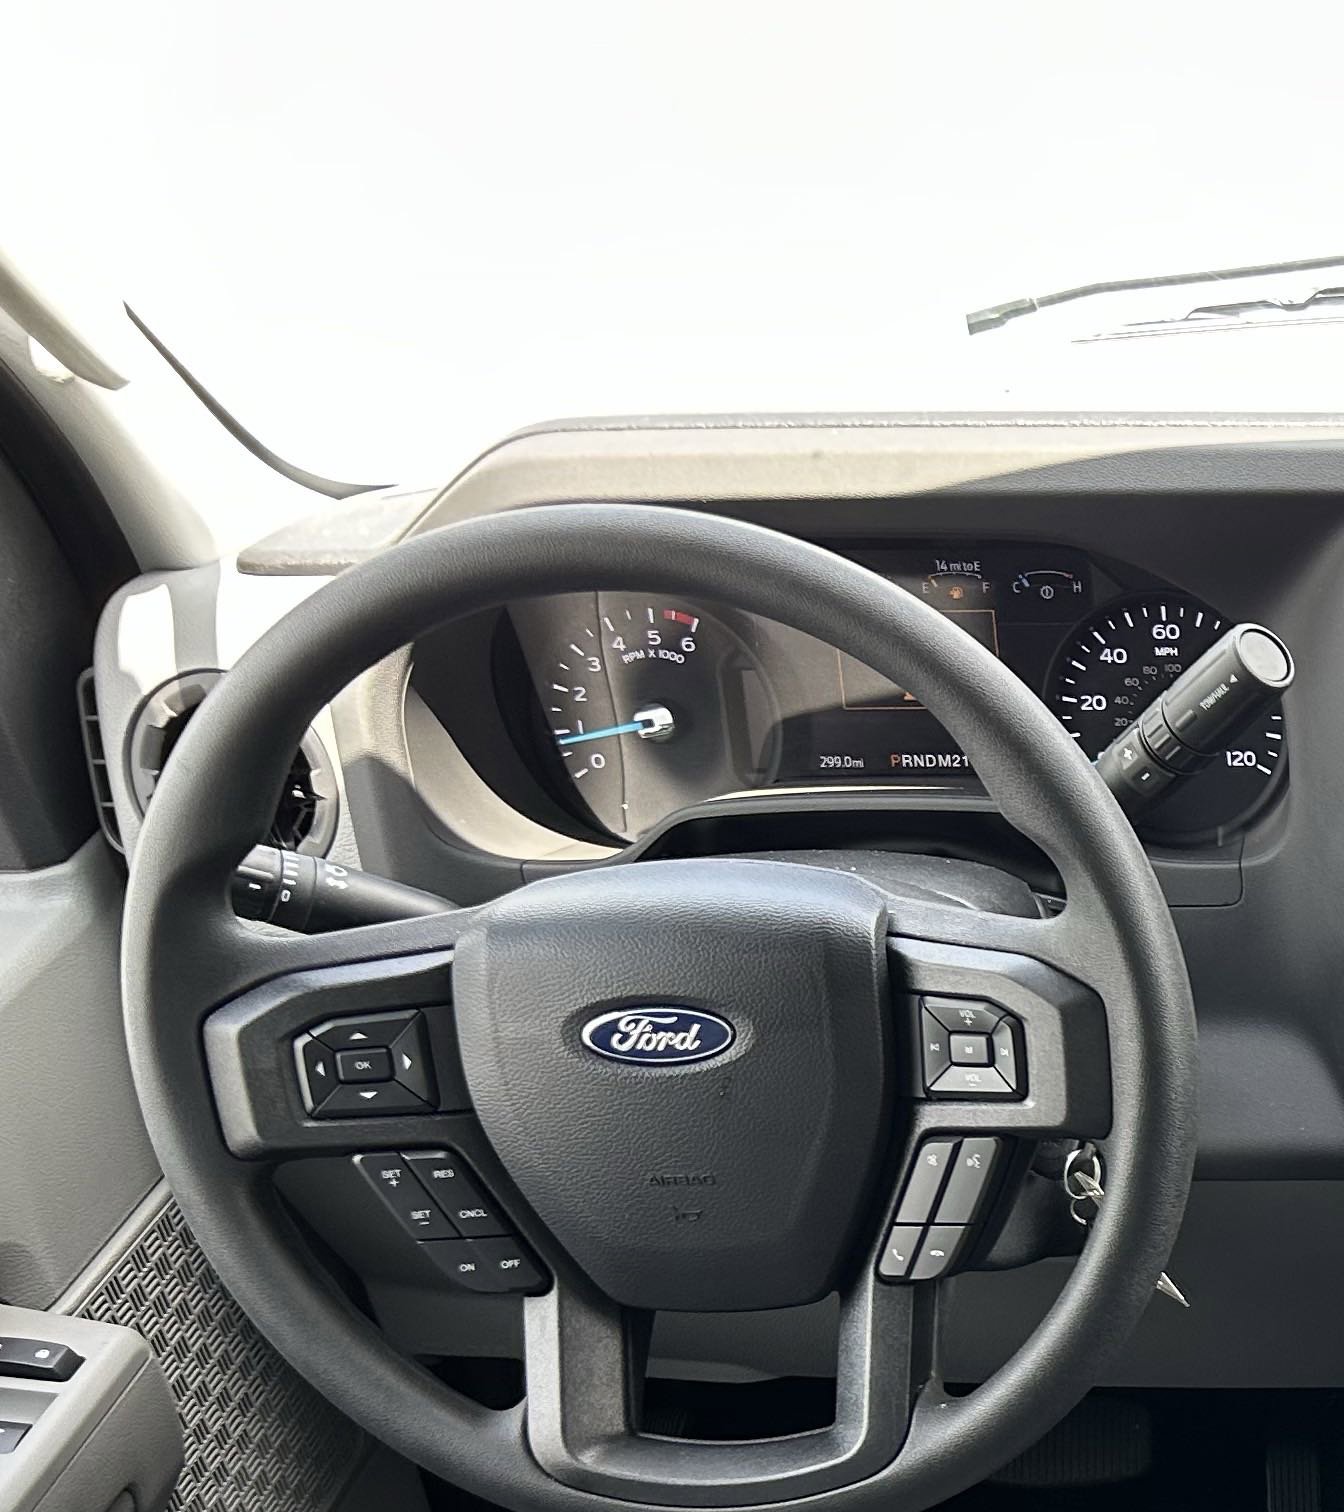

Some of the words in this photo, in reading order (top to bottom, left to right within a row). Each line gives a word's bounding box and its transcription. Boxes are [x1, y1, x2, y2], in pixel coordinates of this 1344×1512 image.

[936, 560, 948, 571] 14
[922, 582, 929, 594] E
[982, 582, 989, 593] F
[1013, 582, 1021, 593] C
[1073, 581, 1082, 593] H
[1152, 624, 1180, 640] 60
[647, 630, 662, 646] 5
[612, 636, 626, 652] 4
[681, 637, 696, 652] 6
[622, 649, 645, 665] RPM
[658, 650, 685, 664] 1000
[1100, 648, 1128, 664] 40
[1154, 646, 1179, 657] MPH
[587, 657, 602, 672] 3
[1142, 665, 1158, 675] 80
[1124, 677, 1140, 687] 60
[573, 687, 588, 702] 2
[1114, 695, 1129, 705] 40
[1080, 695, 1107, 711] 20
[1114, 717, 1129, 727] 20
[590, 754, 606, 769] 0
[1226, 751, 1257, 767] 120
[959, 1009, 976, 1018] VOL
[611, 1014, 701, 1051] Ford
[355, 1061, 372, 1070] OK
[381, 1169, 401, 1179] SET
[410, 1209, 431, 1220] SET
[458, 1208, 488, 1219] CNCL
[458, 1263, 476, 1272] ON
[501, 1258, 521, 1269] OFF
